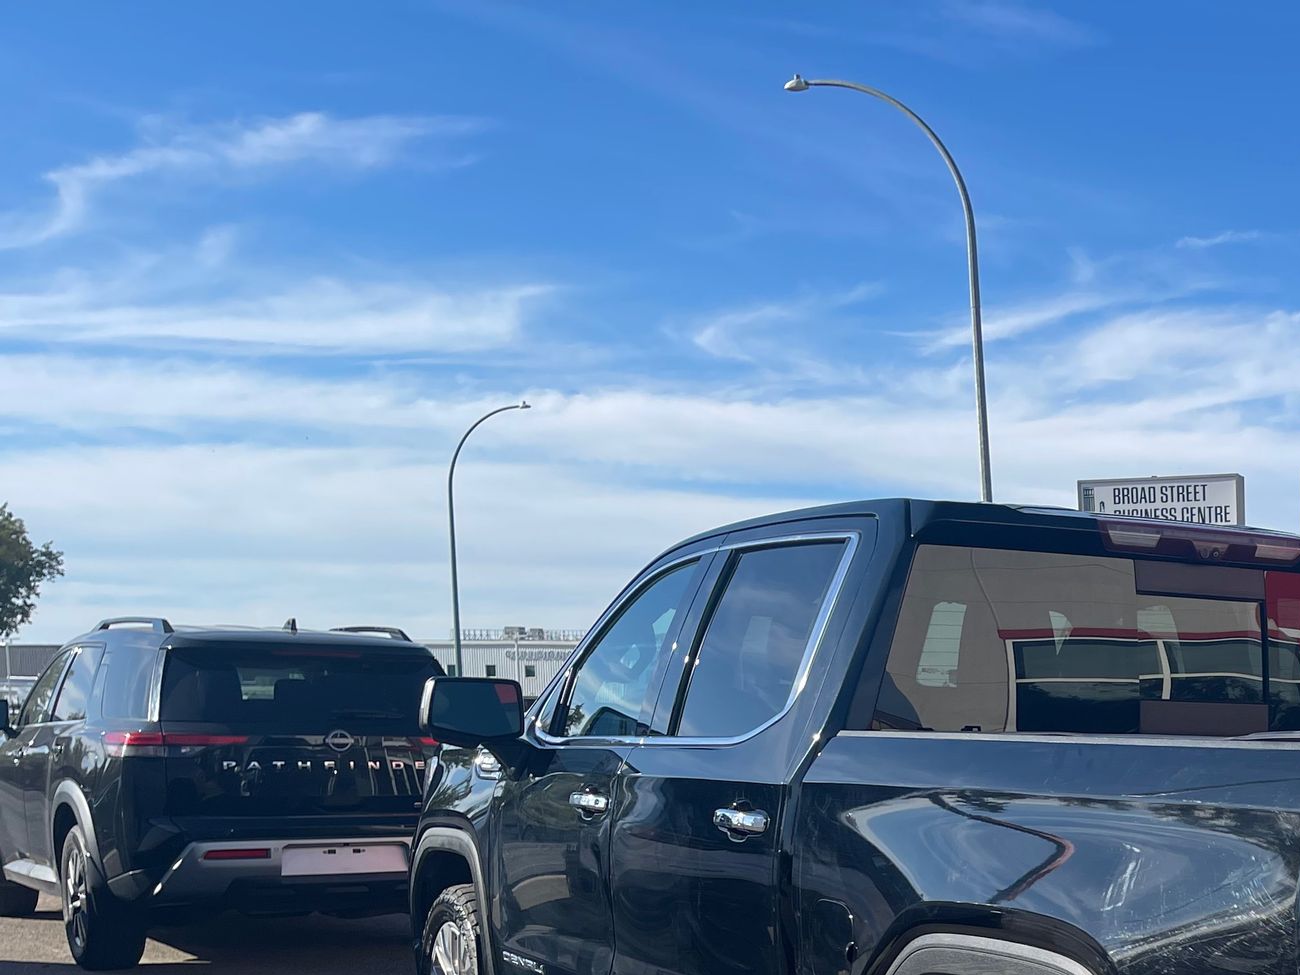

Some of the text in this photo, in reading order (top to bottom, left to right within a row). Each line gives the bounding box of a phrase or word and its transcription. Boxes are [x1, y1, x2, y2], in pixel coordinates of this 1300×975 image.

[1113, 484, 1207, 505] BROAD STREET
[1113, 505, 1231, 524] INESS CENTRE
[222, 760, 426, 770] PATHFINDE
